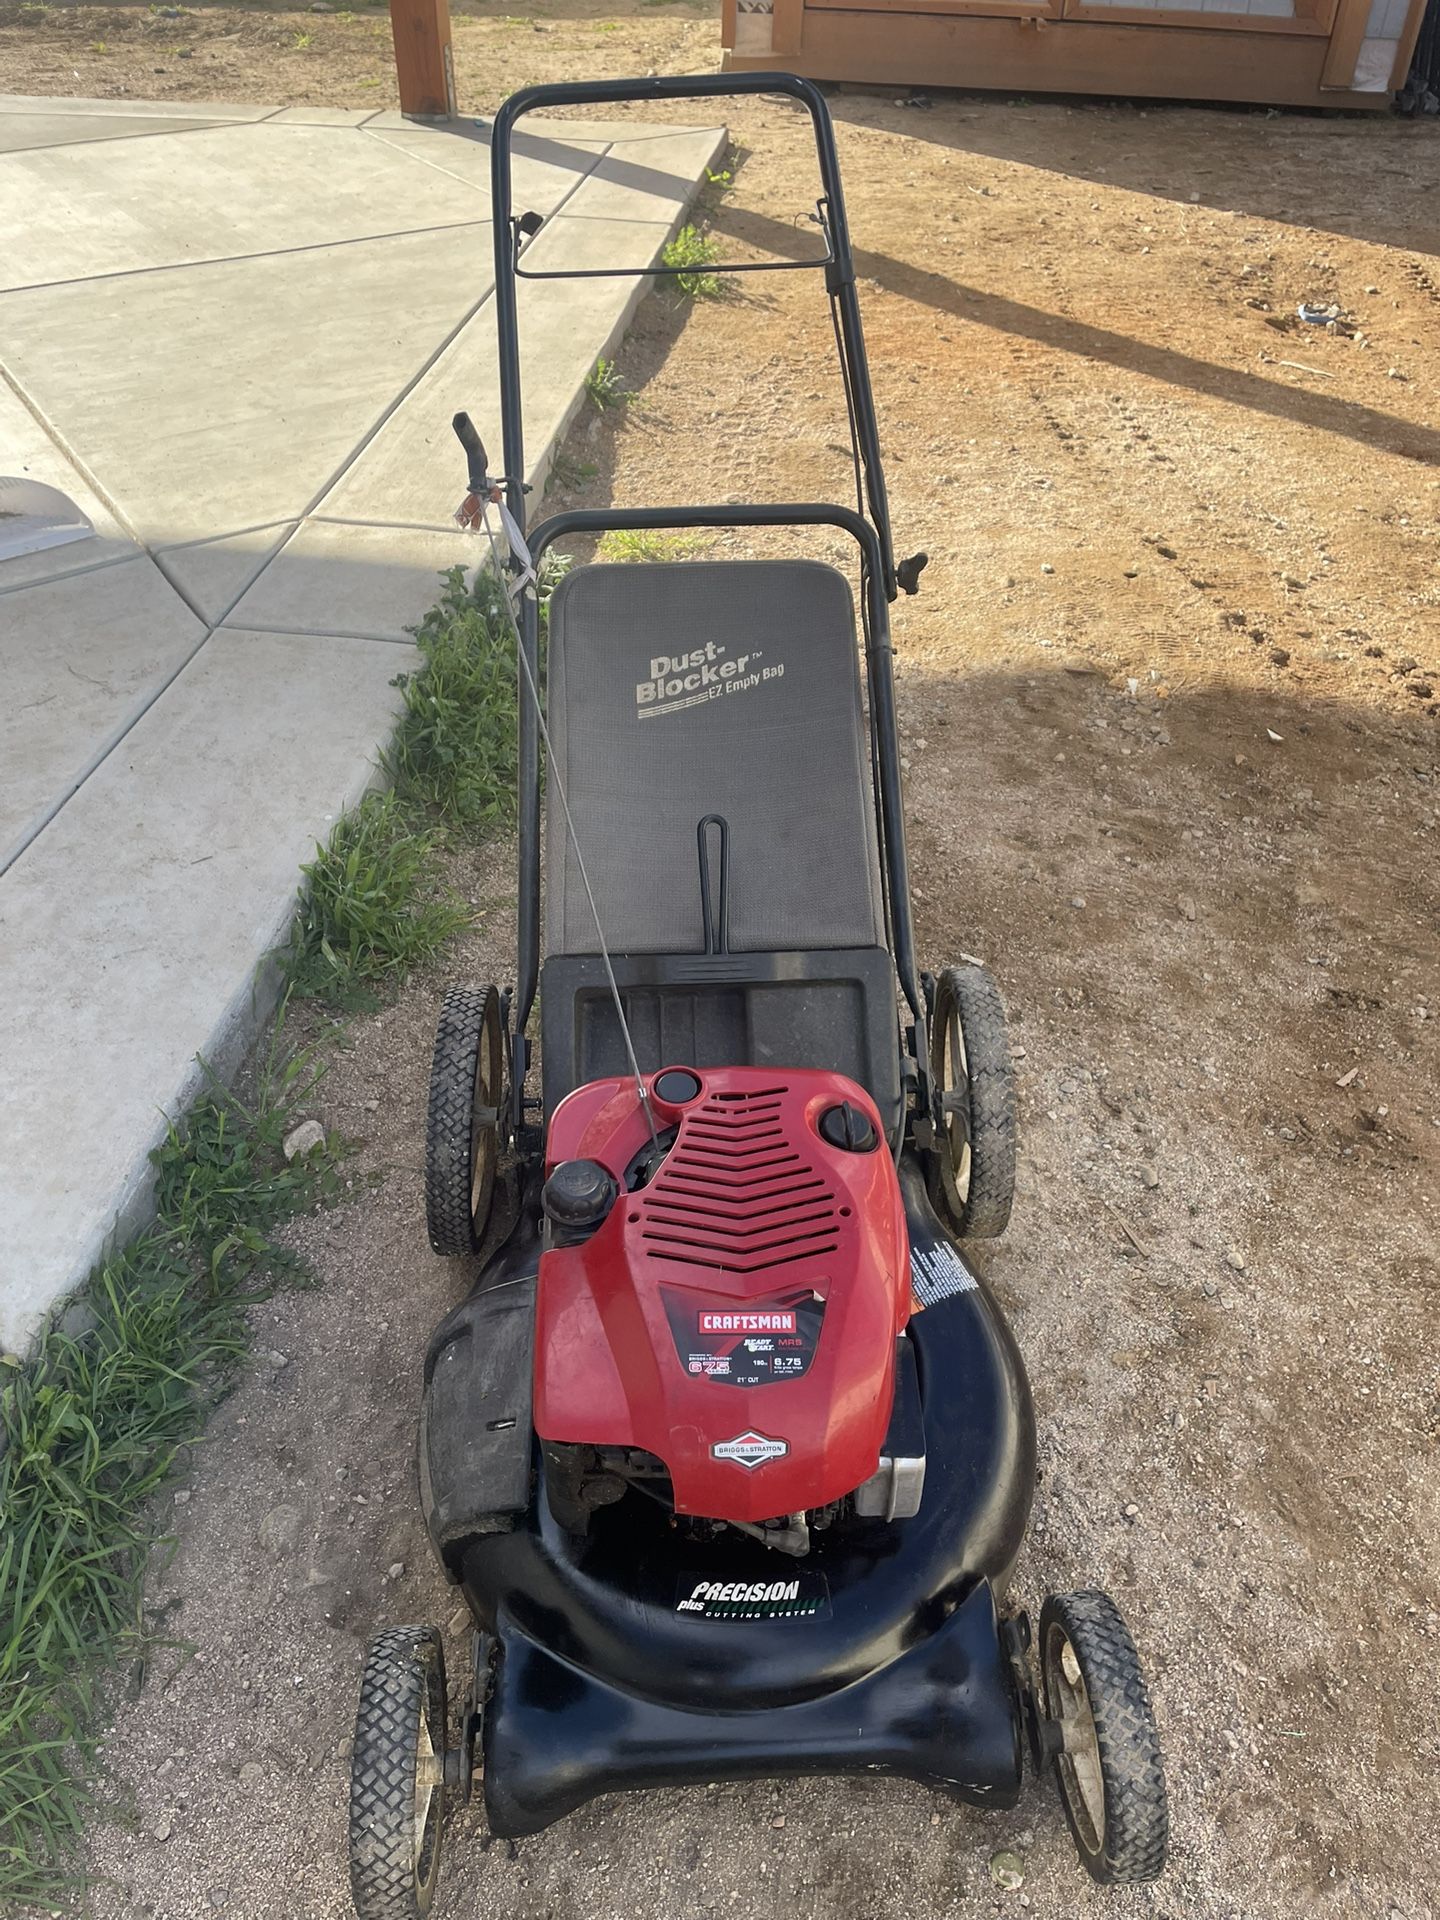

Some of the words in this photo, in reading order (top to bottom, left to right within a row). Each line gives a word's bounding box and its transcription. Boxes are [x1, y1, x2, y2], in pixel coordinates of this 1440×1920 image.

[650, 640, 726, 680] Dust-
[636, 654, 749, 704] Blocker
[708, 684, 724, 699] EZ
[726, 673, 760, 694] Empty
[762, 663, 785, 681] Bag
[703, 1315, 792, 1330] CRAFTSMAN
[689, 1361, 730, 1373] 675
[774, 1357, 802, 1366] 6.75
[691, 1580, 800, 1602] PRECISION
[676, 1599, 706, 1612] plus
[705, 1610, 761, 1619] CUTTING
[769, 1608, 816, 1619] SYSTEM
